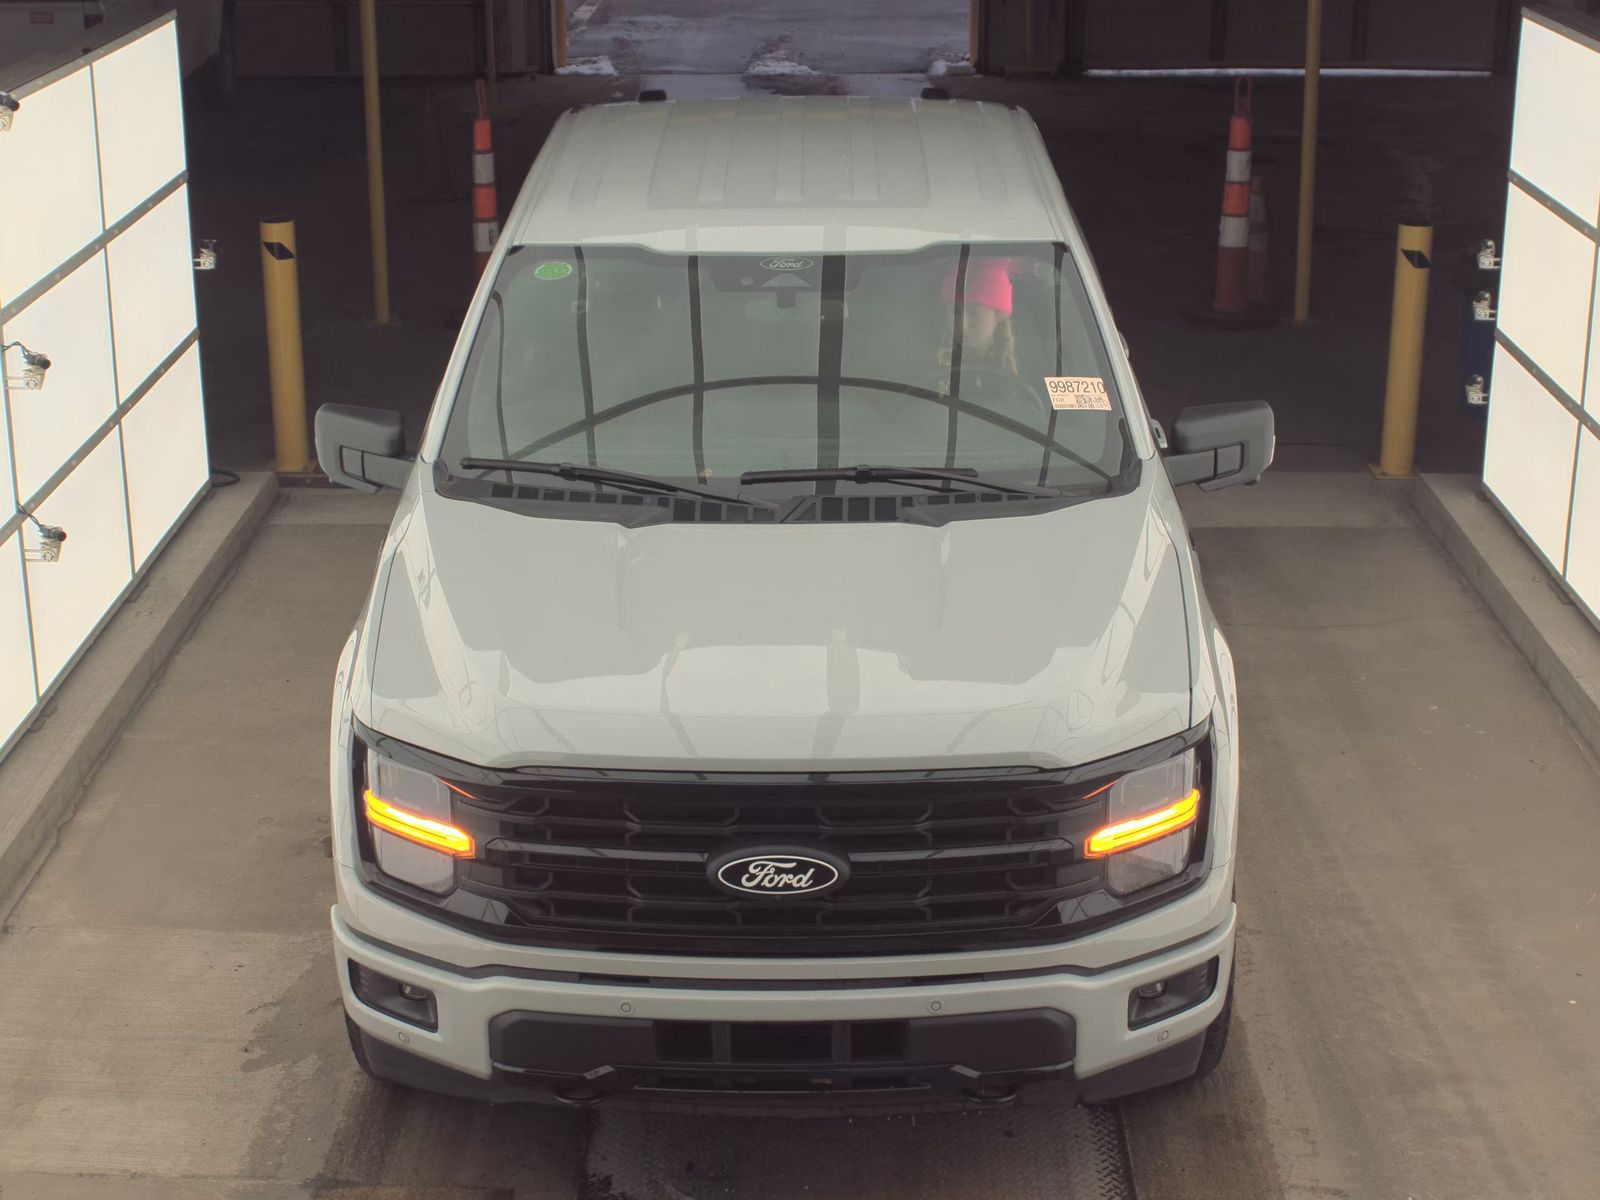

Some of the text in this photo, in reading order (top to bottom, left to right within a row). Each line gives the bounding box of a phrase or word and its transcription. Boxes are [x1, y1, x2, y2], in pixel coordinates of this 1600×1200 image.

[769, 258, 804, 268] Ford
[1048, 380, 1106, 394] 9987210
[741, 860, 815, 888] Ford
